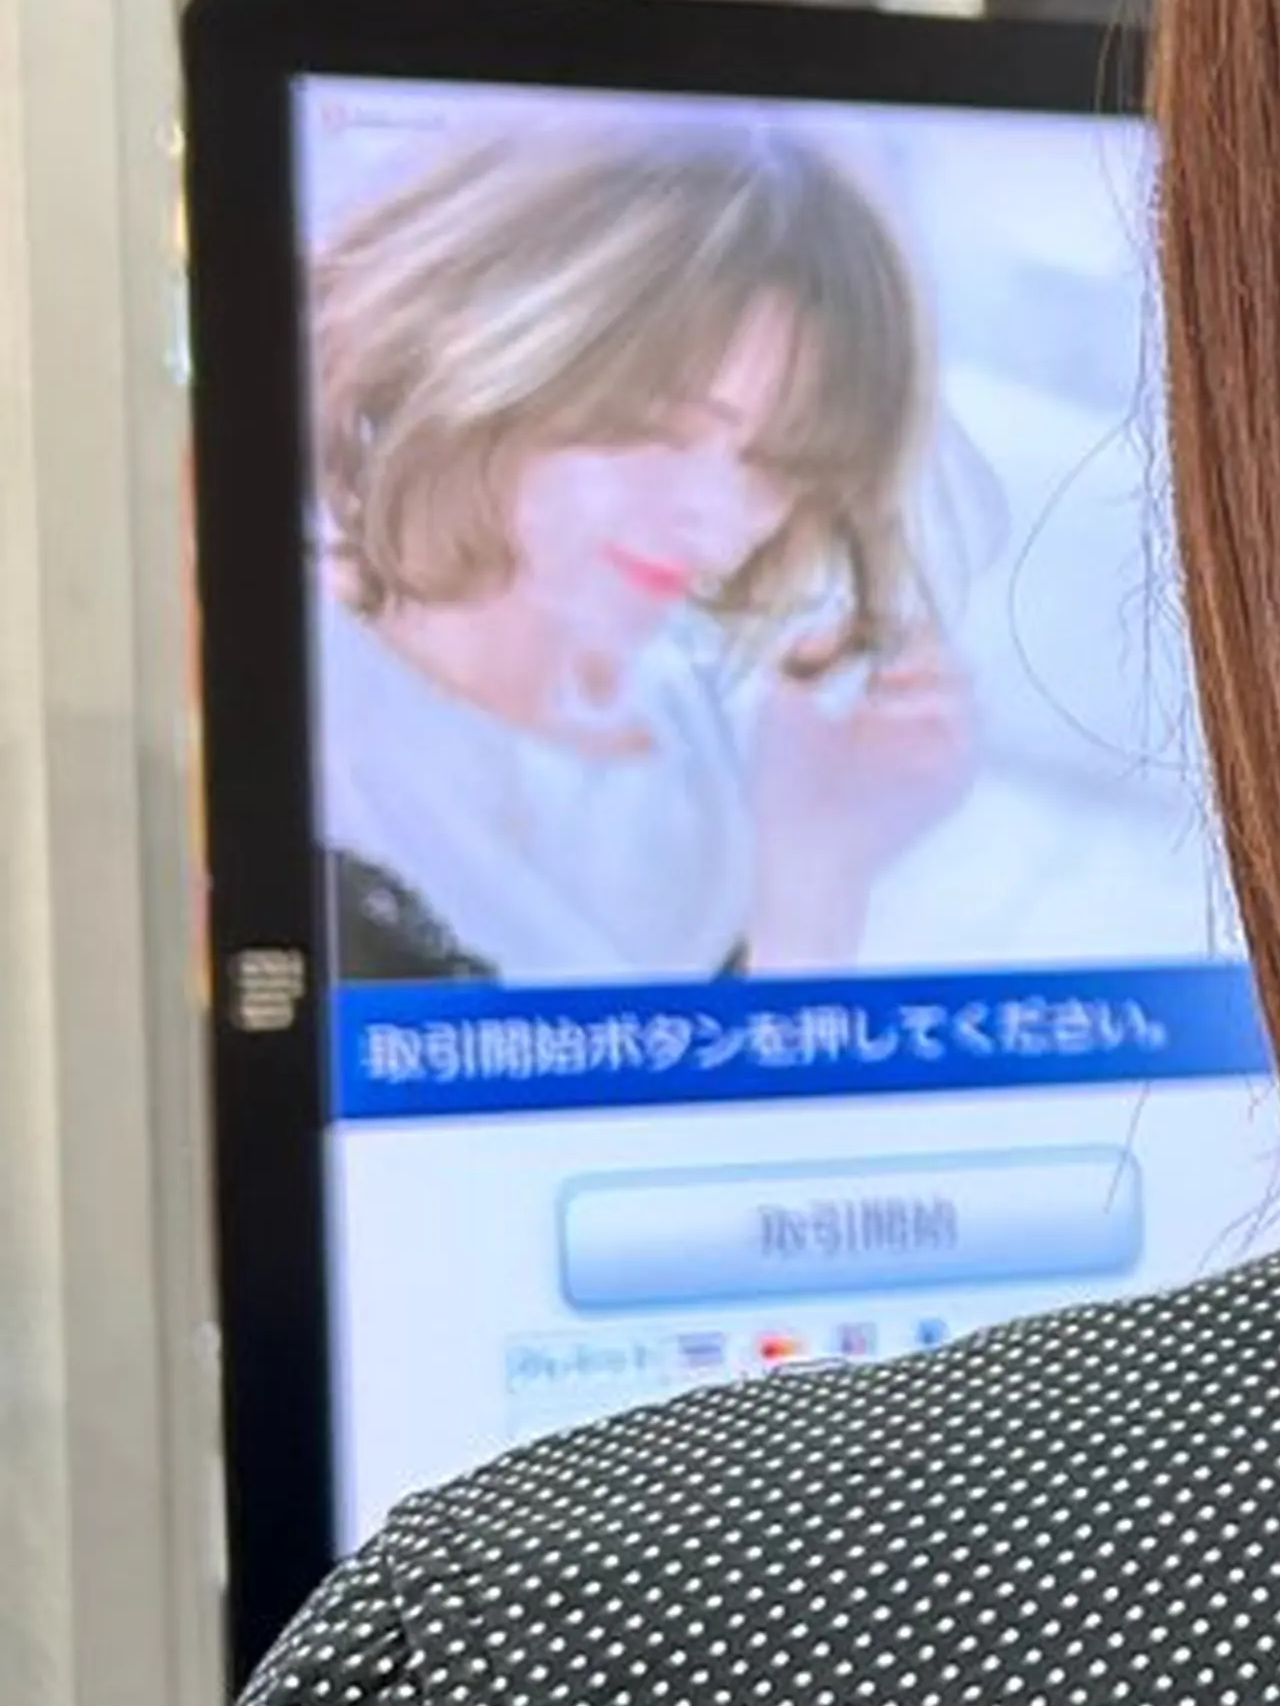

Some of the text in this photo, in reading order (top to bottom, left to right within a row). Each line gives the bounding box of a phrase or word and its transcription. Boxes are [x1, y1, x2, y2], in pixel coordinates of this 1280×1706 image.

[364, 996, 1168, 1083] 取引開始ボタンを押してください。
